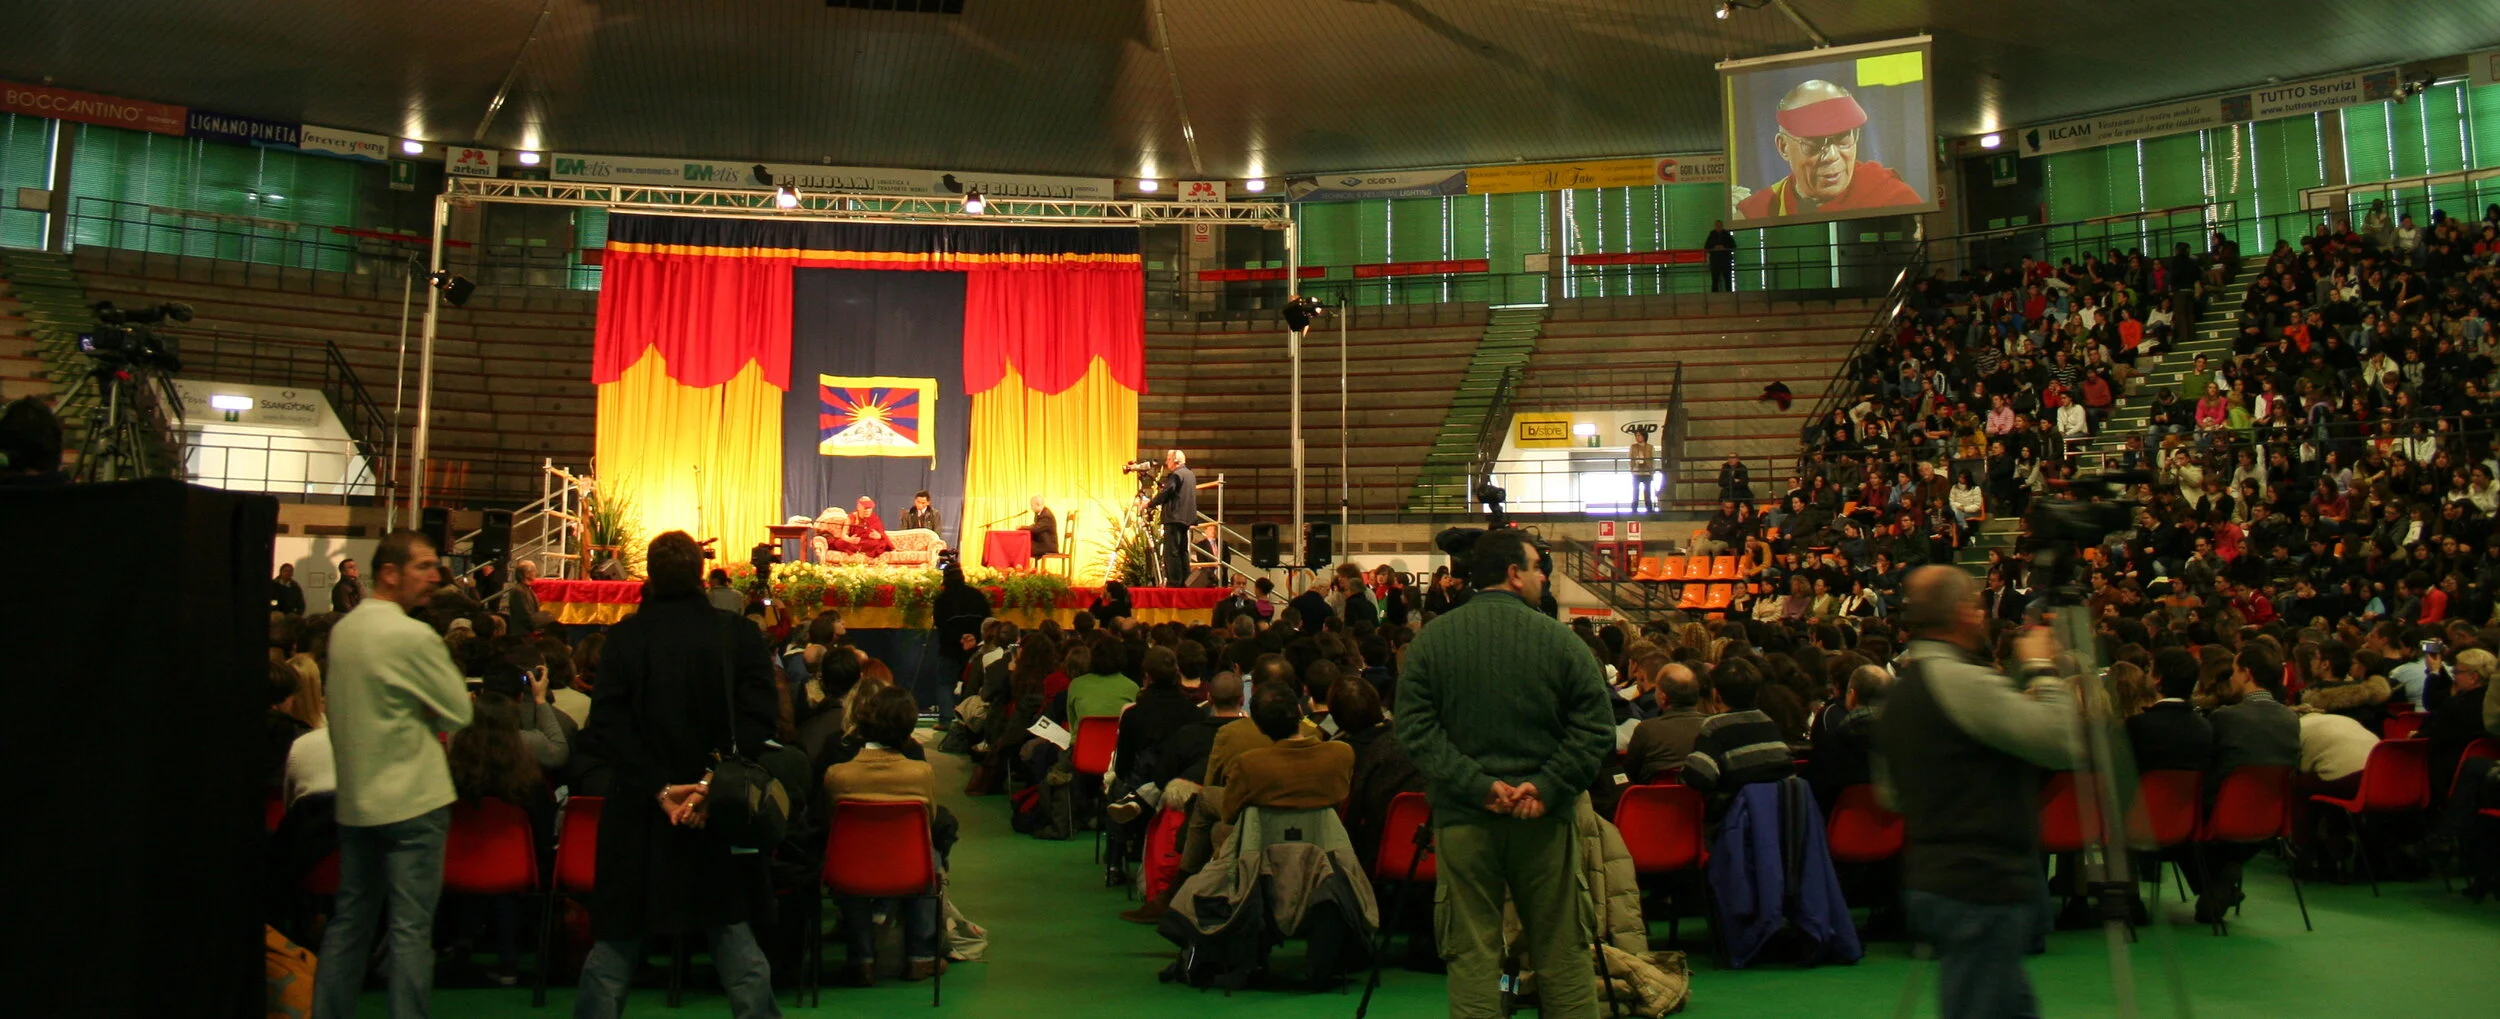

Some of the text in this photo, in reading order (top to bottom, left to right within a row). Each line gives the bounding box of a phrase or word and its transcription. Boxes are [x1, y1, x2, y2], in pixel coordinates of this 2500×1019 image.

[2258, 78, 2357, 104] TUTTO Servizi
[6, 89, 140, 122] BOCCANTINO
[2260, 95, 2357, 115] www.tuttoservizi.org
[190, 113, 297, 143] LIGNANO PINETA
[2048, 123, 2092, 141] ILCAM
[301, 131, 385, 155] forever young
[452, 165, 490, 176] arteni
[561, 159, 612, 177] Metis
[689, 164, 740, 183] Metis
[1399, 189, 1432, 197] LIGHTING
[260, 399, 316, 412] SSANGYONG
[1625, 424, 1658, 434] AND
